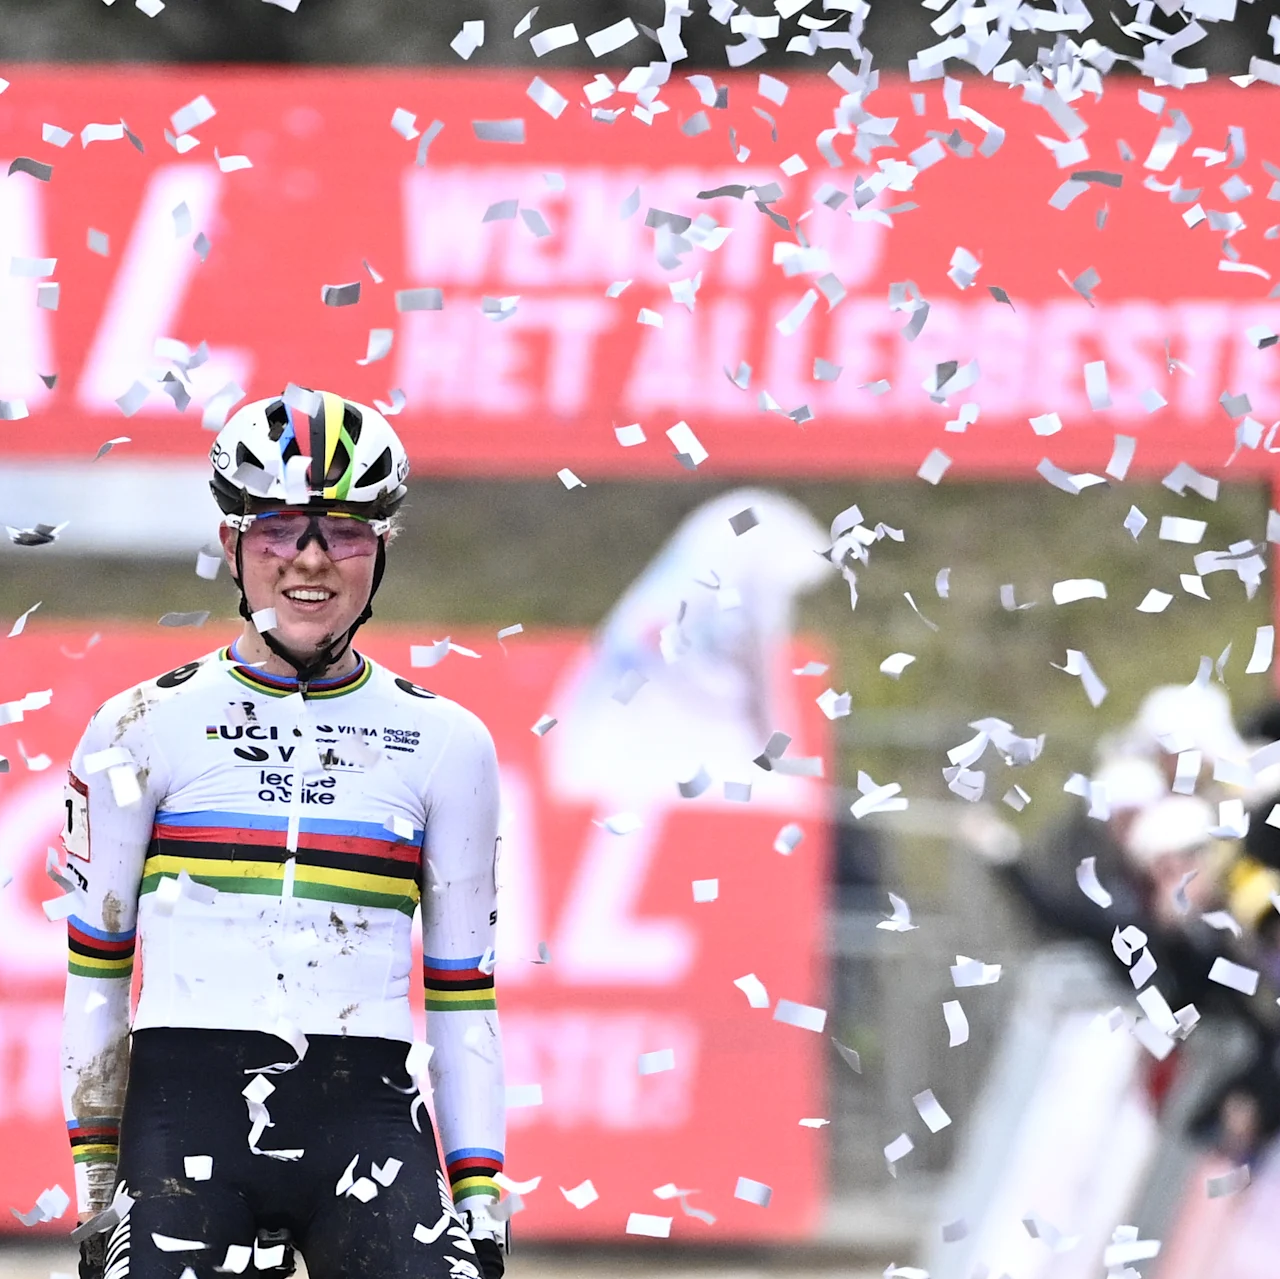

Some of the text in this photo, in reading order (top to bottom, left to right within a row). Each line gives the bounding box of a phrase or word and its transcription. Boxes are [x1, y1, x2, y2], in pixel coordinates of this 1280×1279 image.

[400, 162, 778, 289] WENST
[397, 294, 626, 420] HET
[219, 725, 279, 740] UCI
[384, 727, 420, 738] lease
